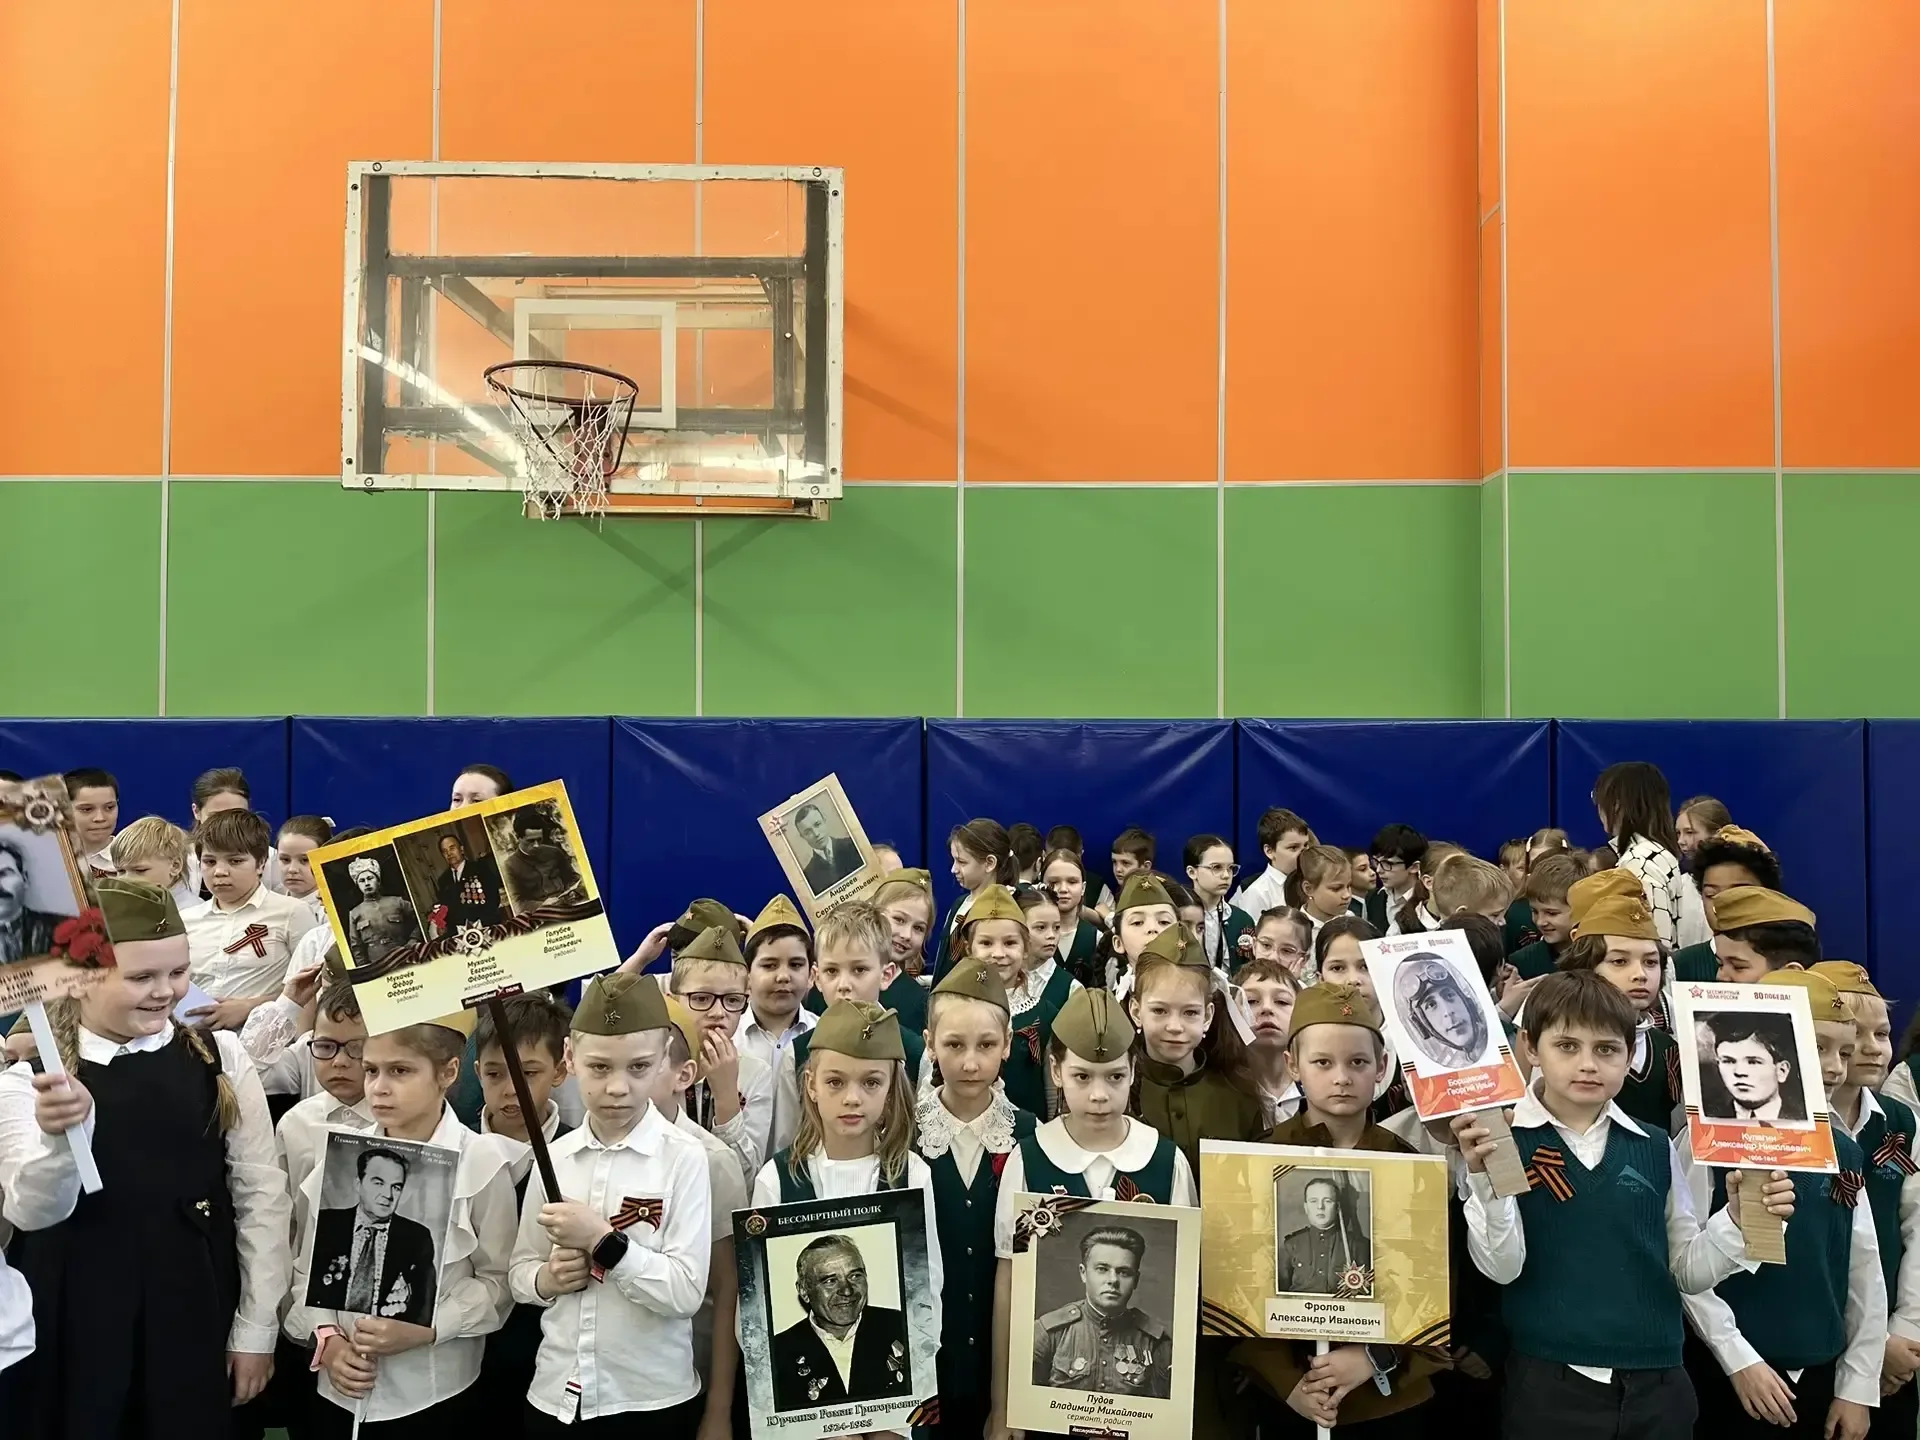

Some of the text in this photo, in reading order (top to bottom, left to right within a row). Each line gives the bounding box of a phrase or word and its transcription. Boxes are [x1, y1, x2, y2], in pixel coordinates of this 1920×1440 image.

[828, 877, 858, 898] Андреев
[815, 874, 879, 919] Сергей Васильевич
[546, 926, 571, 937] Голубев
[547, 932, 574, 944] Николай
[544, 939, 582, 953] Васильевич
[470, 962, 497, 975] Евгений
[1754, 991, 1791, 1001] 80 ПОБЕДА!
[1741, 1132, 1777, 1143] Кулагин
[1711, 1139, 1811, 1153] Александр Николаевич
[778, 1205, 882, 1225] БЕССМЕРТНЫЙ ПОЛК
[1304, 1302, 1346, 1312] Фролов
[1270, 1313, 1380, 1326] Александр Иванович
[1087, 1394, 1114, 1405] Пудов
[766, 1399, 922, 1427] Юрченко Роман Григорьевич
[1050, 1400, 1153, 1419] Владимир Михайлович
[1067, 1413, 1132, 1426] сержант, радист
